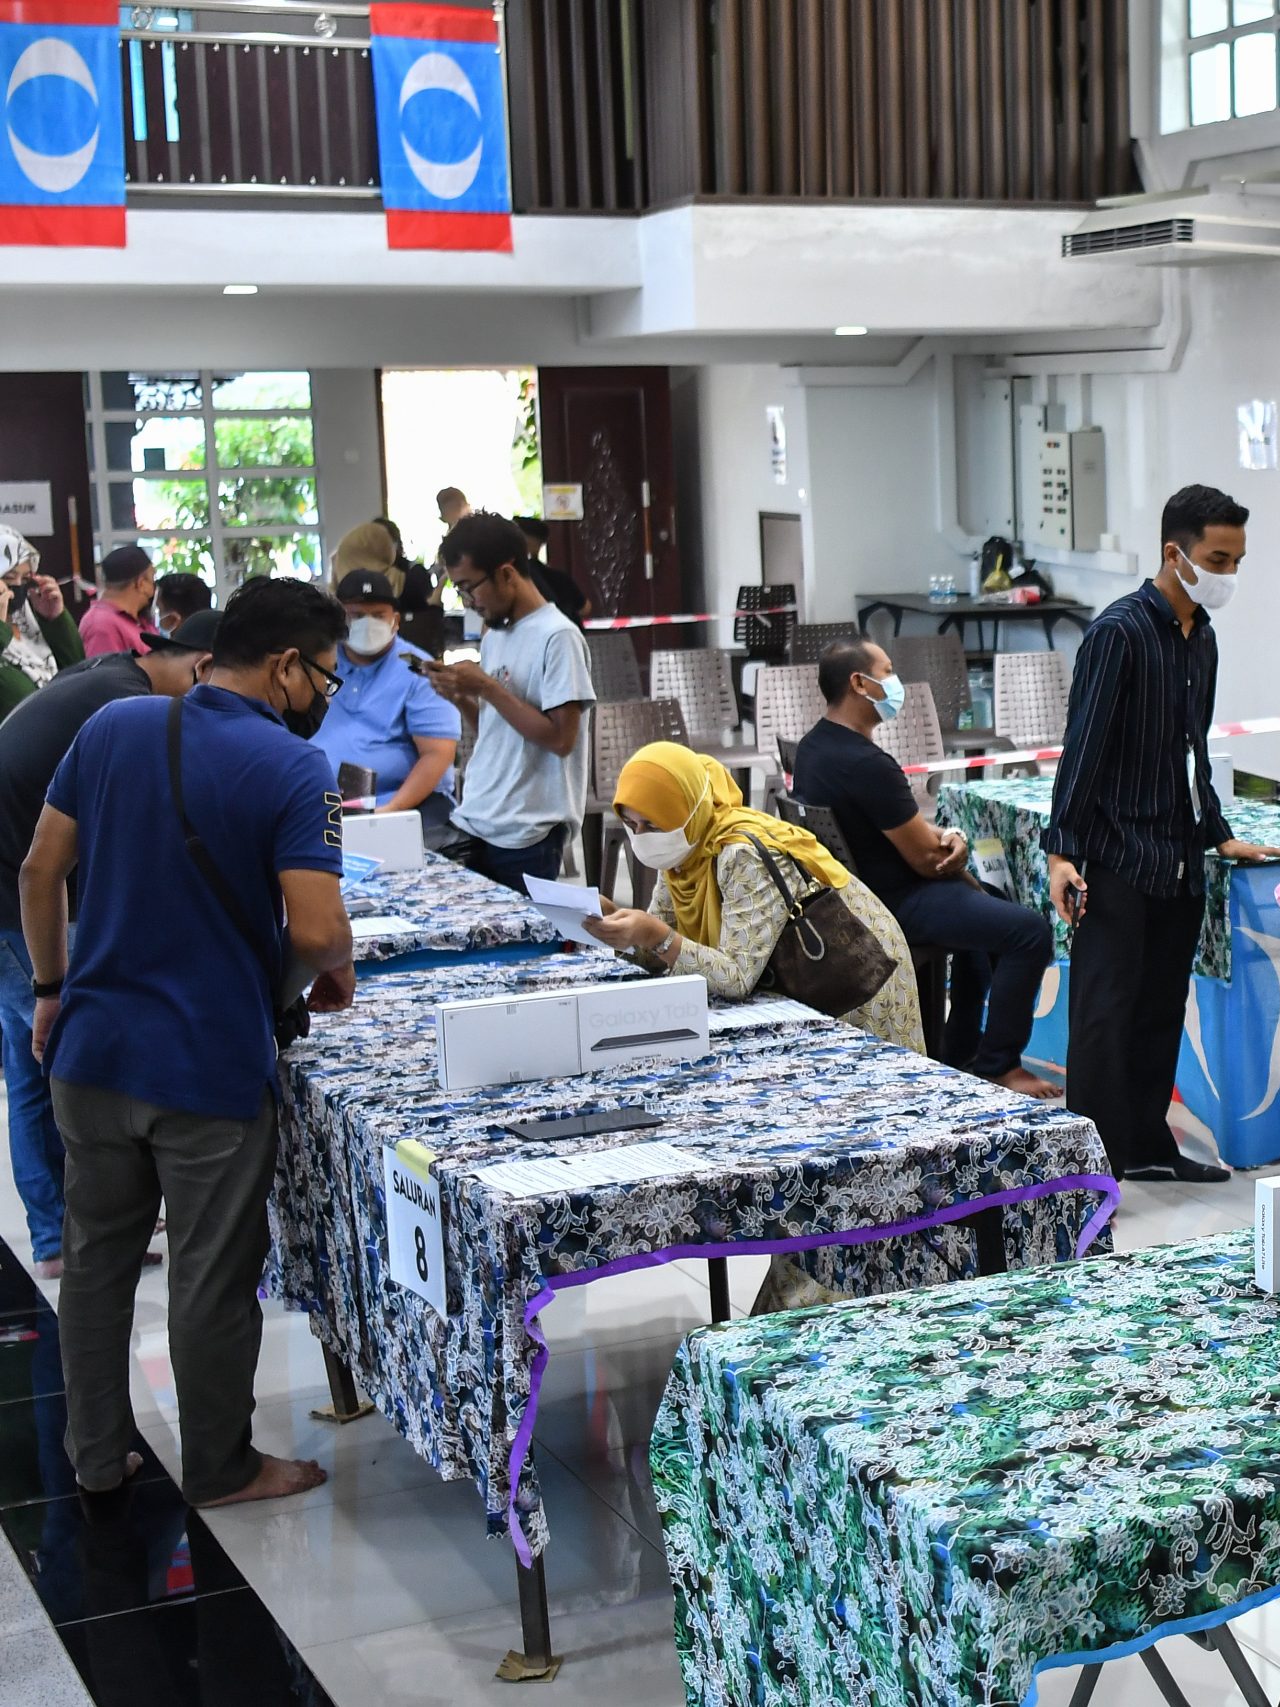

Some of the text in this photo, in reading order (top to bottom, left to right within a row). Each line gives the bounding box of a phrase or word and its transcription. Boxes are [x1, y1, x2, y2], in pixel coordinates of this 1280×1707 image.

[0, 503, 36, 514] ASUK
[589, 1003, 699, 1028] Galaxy Tab
[392, 1170, 437, 1220] SALURAN
[414, 1225, 429, 1283] 8
